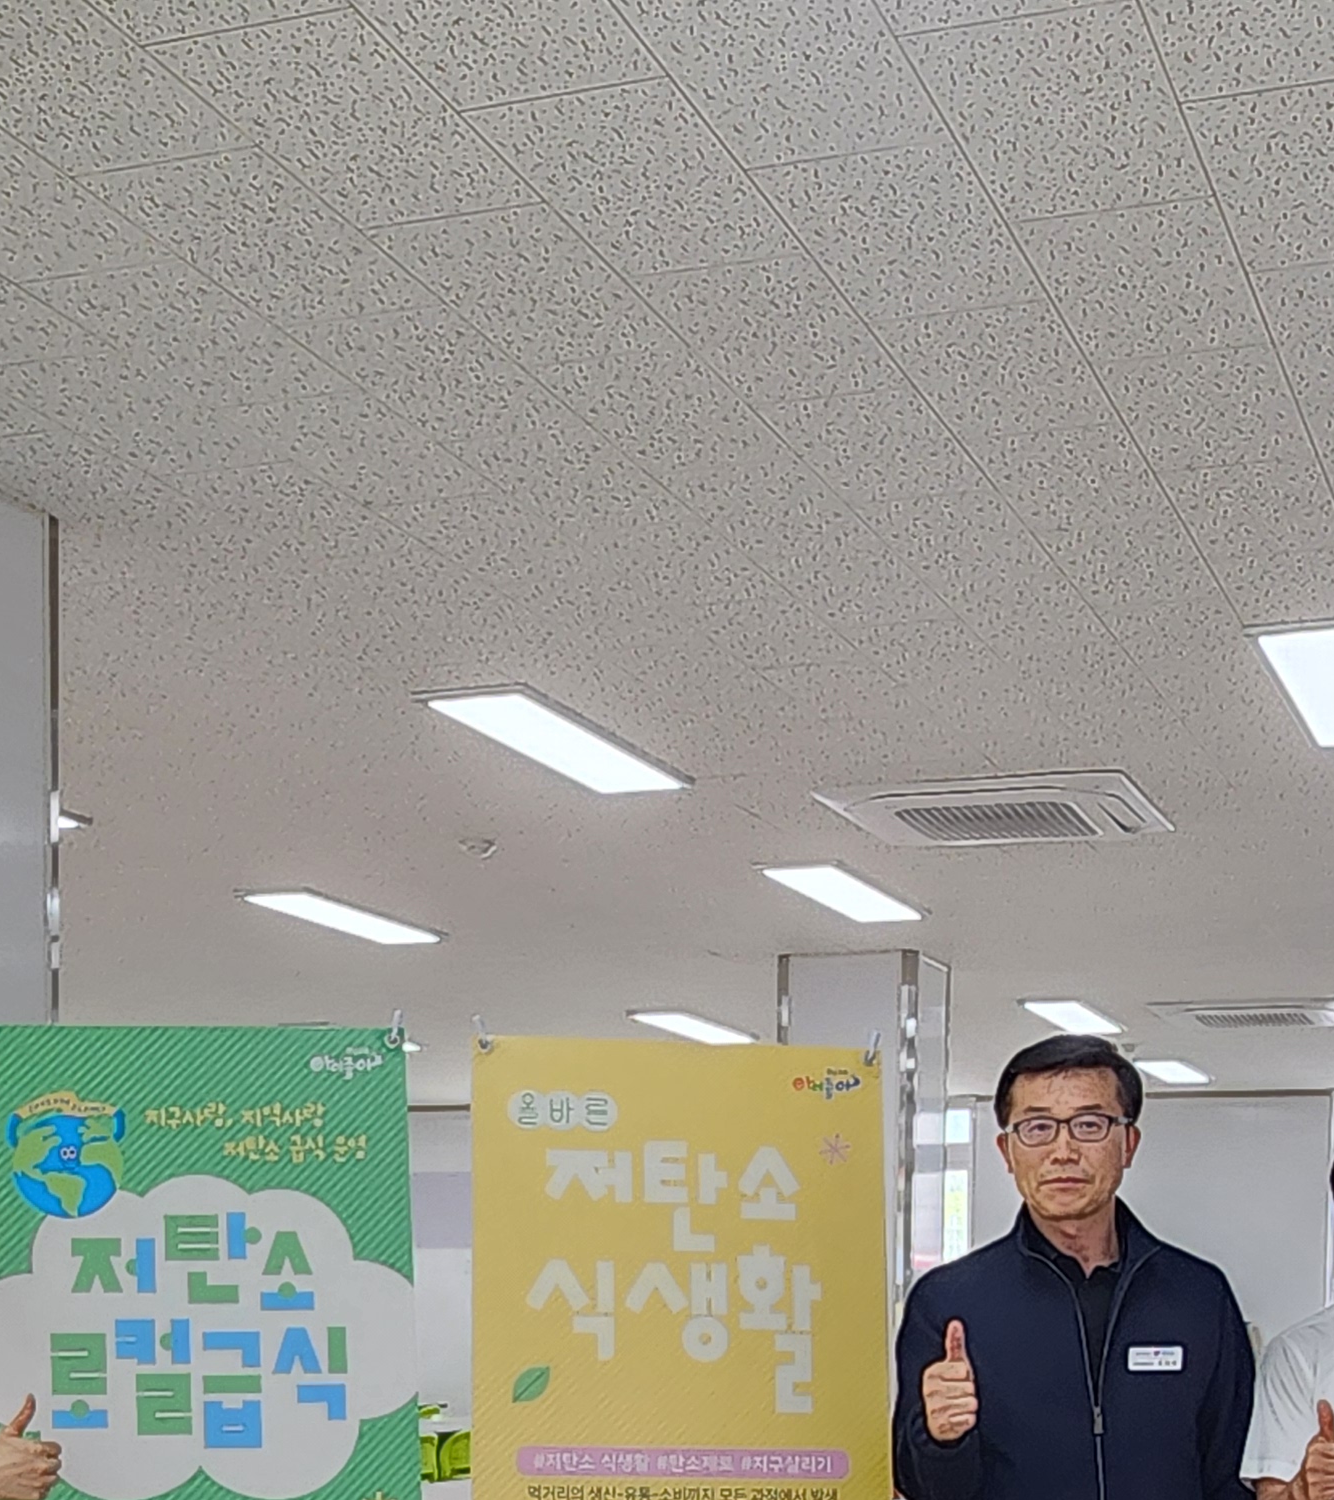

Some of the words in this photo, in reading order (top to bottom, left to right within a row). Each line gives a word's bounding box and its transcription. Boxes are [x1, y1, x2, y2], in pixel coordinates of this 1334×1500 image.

[241, 1101, 325, 1128] 지역사랑
[516, 1091, 609, 1126] 올바른
[224, 1136, 279, 1161] 저탄소
[289, 1136, 325, 1162] 급식
[333, 1134, 367, 1162] 운영
[544, 1140, 801, 1252] 저탄소
[71, 1212, 315, 1311] 저탄소
[526, 1245, 821, 1414] 식생활
[50, 1318, 348, 1449] 로컬급식
[534, 1452, 596, 1471] #저탄소
[601, 1453, 650, 1472] 식생활
[741, 1455, 832, 1474] #지구살리기
